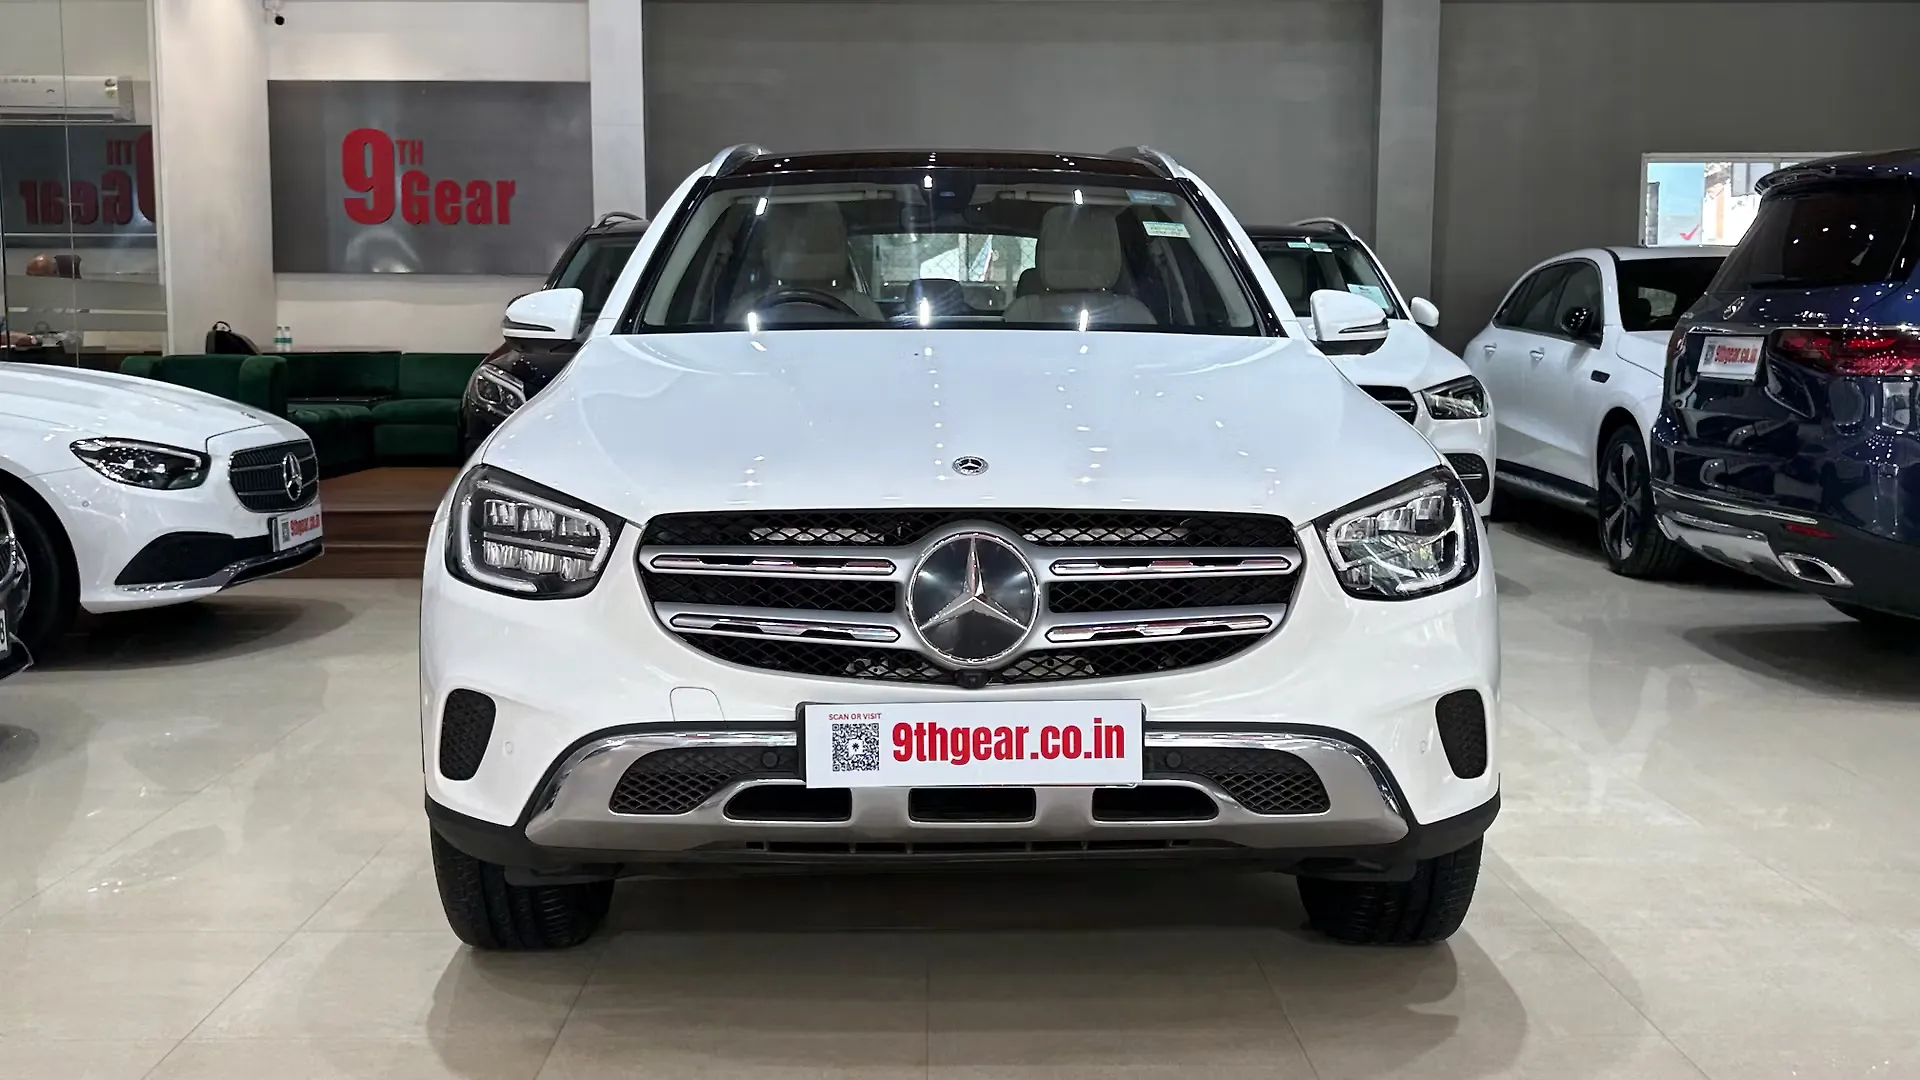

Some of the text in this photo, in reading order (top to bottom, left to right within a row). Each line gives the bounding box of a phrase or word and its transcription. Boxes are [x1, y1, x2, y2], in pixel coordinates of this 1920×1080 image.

[401, 169, 516, 225] Gear
[828, 713, 850, 721] SCAN
[862, 712, 882, 720] VISIT
[892, 717, 1125, 766] 9thgear.co.in
